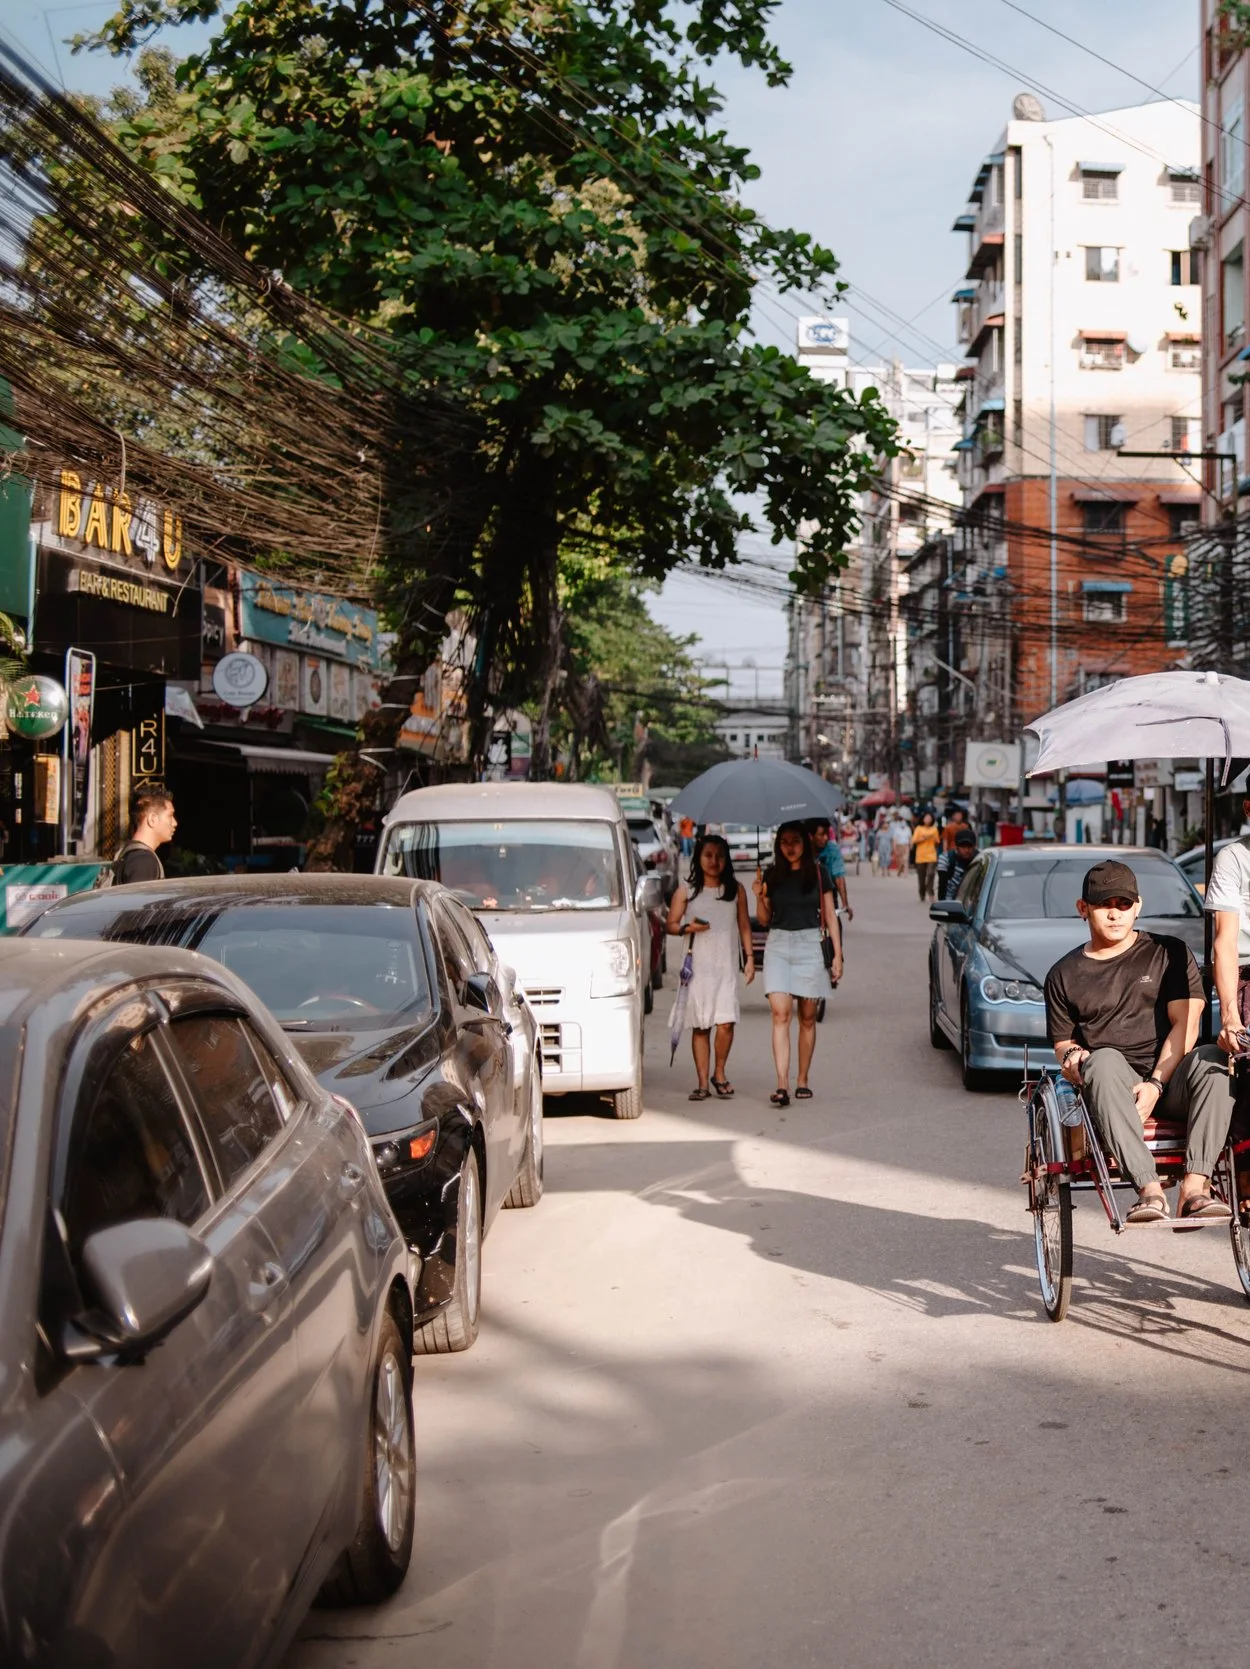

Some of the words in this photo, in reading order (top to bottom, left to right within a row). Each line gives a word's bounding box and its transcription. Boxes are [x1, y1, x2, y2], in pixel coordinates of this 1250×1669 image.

[80, 571, 100, 596] BAR
[101, 575, 110, 598] &
[111, 579, 169, 613] RESTAURANT
